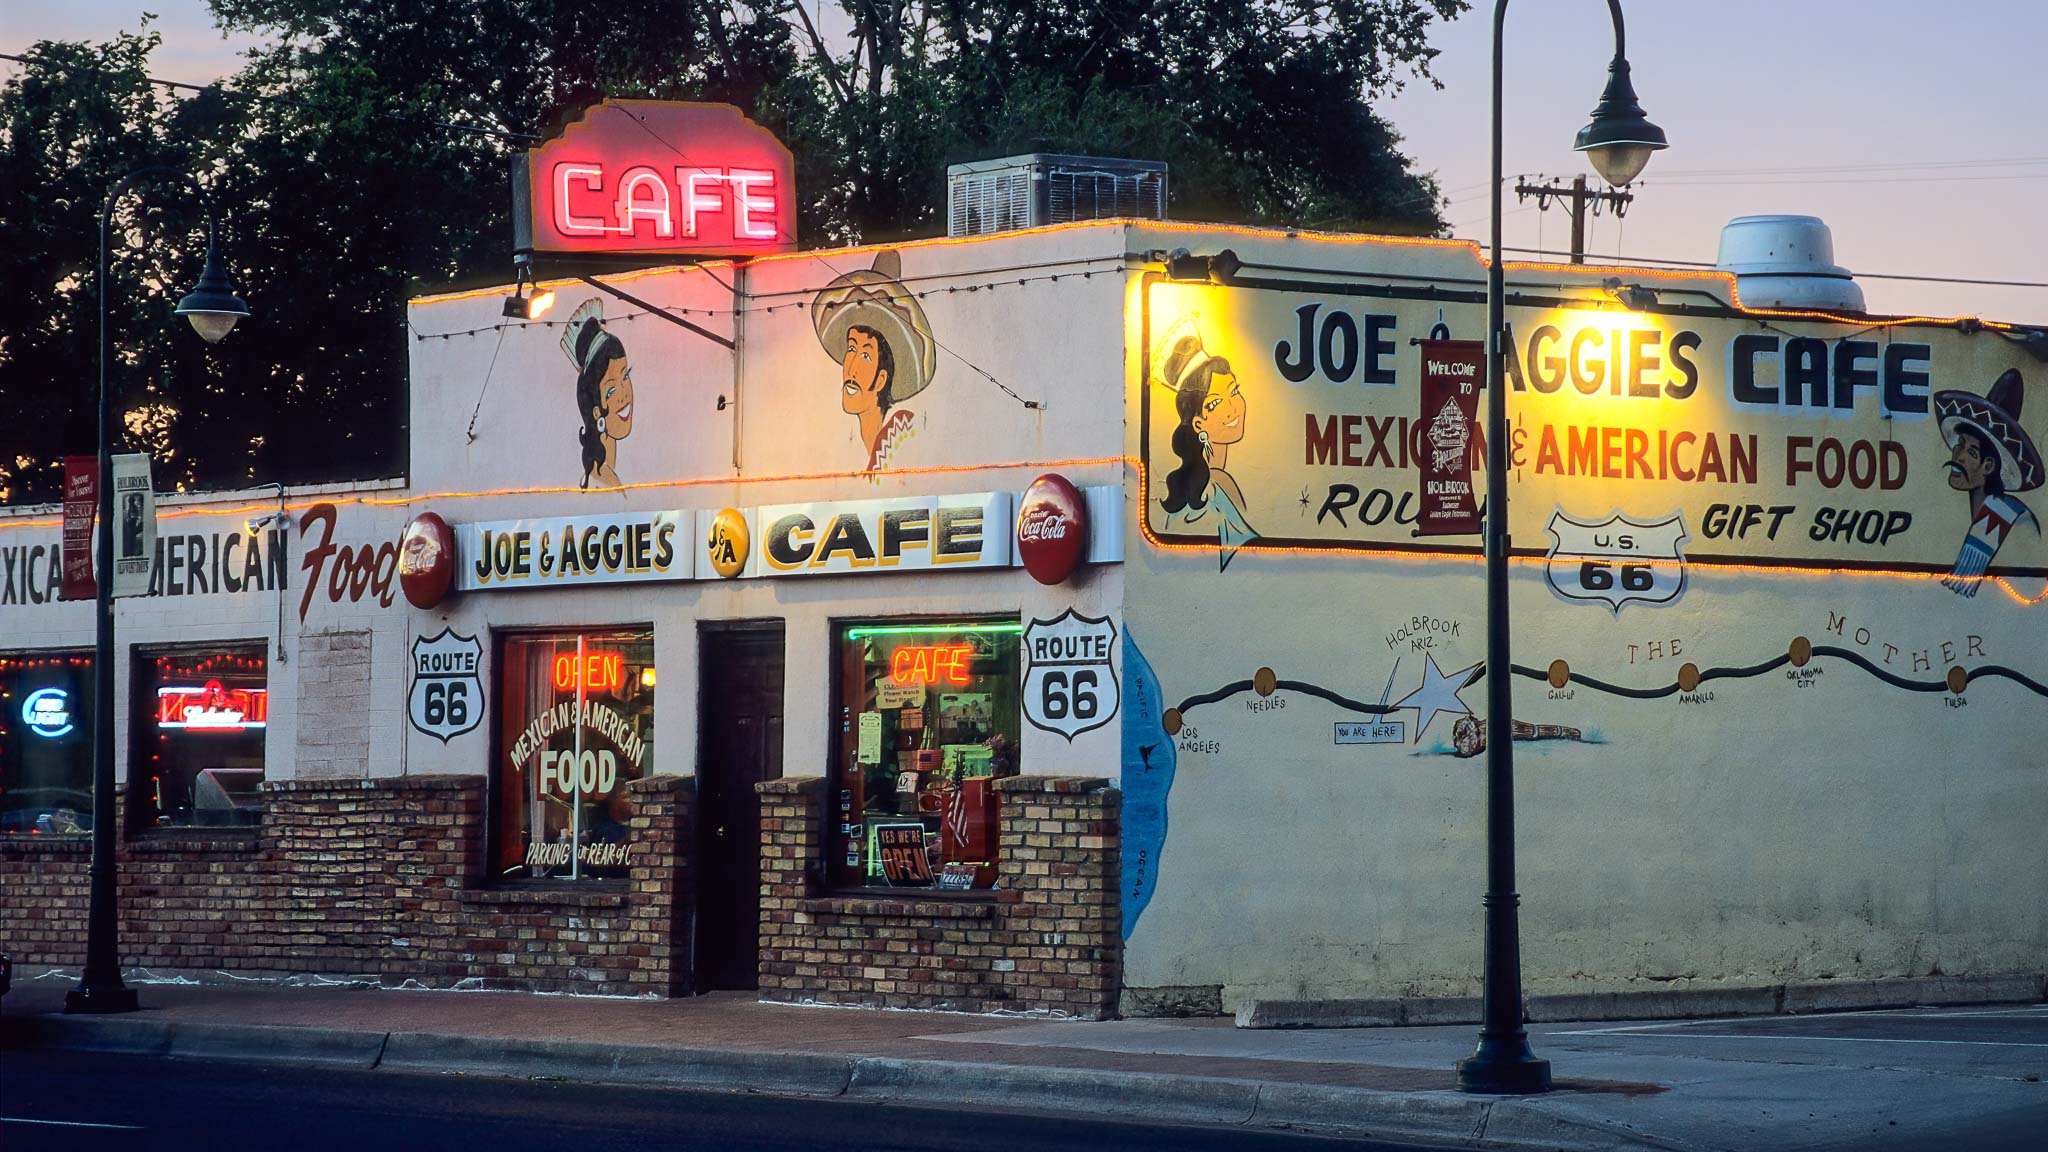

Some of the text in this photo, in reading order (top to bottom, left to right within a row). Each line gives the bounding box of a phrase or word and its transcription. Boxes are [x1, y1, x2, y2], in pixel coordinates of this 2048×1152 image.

[553, 161, 777, 240] CAFE
[1274, 303, 1398, 385] JOE
[1731, 334, 1931, 414] CAFE
[1427, 360, 1476, 376] WELCOME
[1460, 382, 1472, 394] TO
[1305, 413, 1487, 471] MEXIN
[1534, 424, 1758, 484] AMERICAN
[1786, 436, 1908, 490] FOOD
[1427, 481, 1470, 495] HOLBROOK
[1019, 514, 1066, 542] Coca-Cola
[1317, 483, 1912, 545] ROU GIFT SHOP
[763, 506, 984, 570] CAFE
[1593, 533, 1640, 550] U.S.
[0, 543, 64, 605] XICA
[147, 530, 288, 597] MERICAN
[299, 503, 404, 626] Food
[475, 521, 676, 584] JOE & AGGIE'S
[1579, 562, 1655, 592] 66
[1385, 615, 1461, 650] HOLBROOK
[1411, 636, 1438, 653] ARIZ.
[1627, 611, 1986, 673] THE MOTHER
[1035, 634, 1108, 660] ROUTE
[419, 651, 475, 672] ROUTE
[556, 656, 618, 688] OPEN
[893, 647, 971, 683] CAFE
[1786, 666, 1823, 680] OKLAHOMA
[1041, 670, 1099, 720] 66
[1548, 689, 1575, 700] GALLUP
[1678, 691, 1715, 705] AMARILLO
[1797, 679, 1816, 689] CITY
[424, 682, 468, 726] 66
[1246, 697, 1286, 712] NEEDLES
[1944, 697, 1968, 709] TULSA
[510, 701, 569, 771] MEXICAN
[581, 699, 646, 767] AMERICAN
[1182, 727, 1199, 740] LOS
[1353, 726, 1367, 737] ARE
[1372, 725, 1396, 739] HERE
[1178, 740, 1221, 754] ANGELES
[540, 749, 617, 795] FOOD
[880, 830, 921, 844] YES WE'RE
[525, 842, 570, 865] PARKING
[587, 842, 615, 865] REAR
[881, 847, 932, 881] OPEN
[1134, 850, 1147, 899] OCEAN
